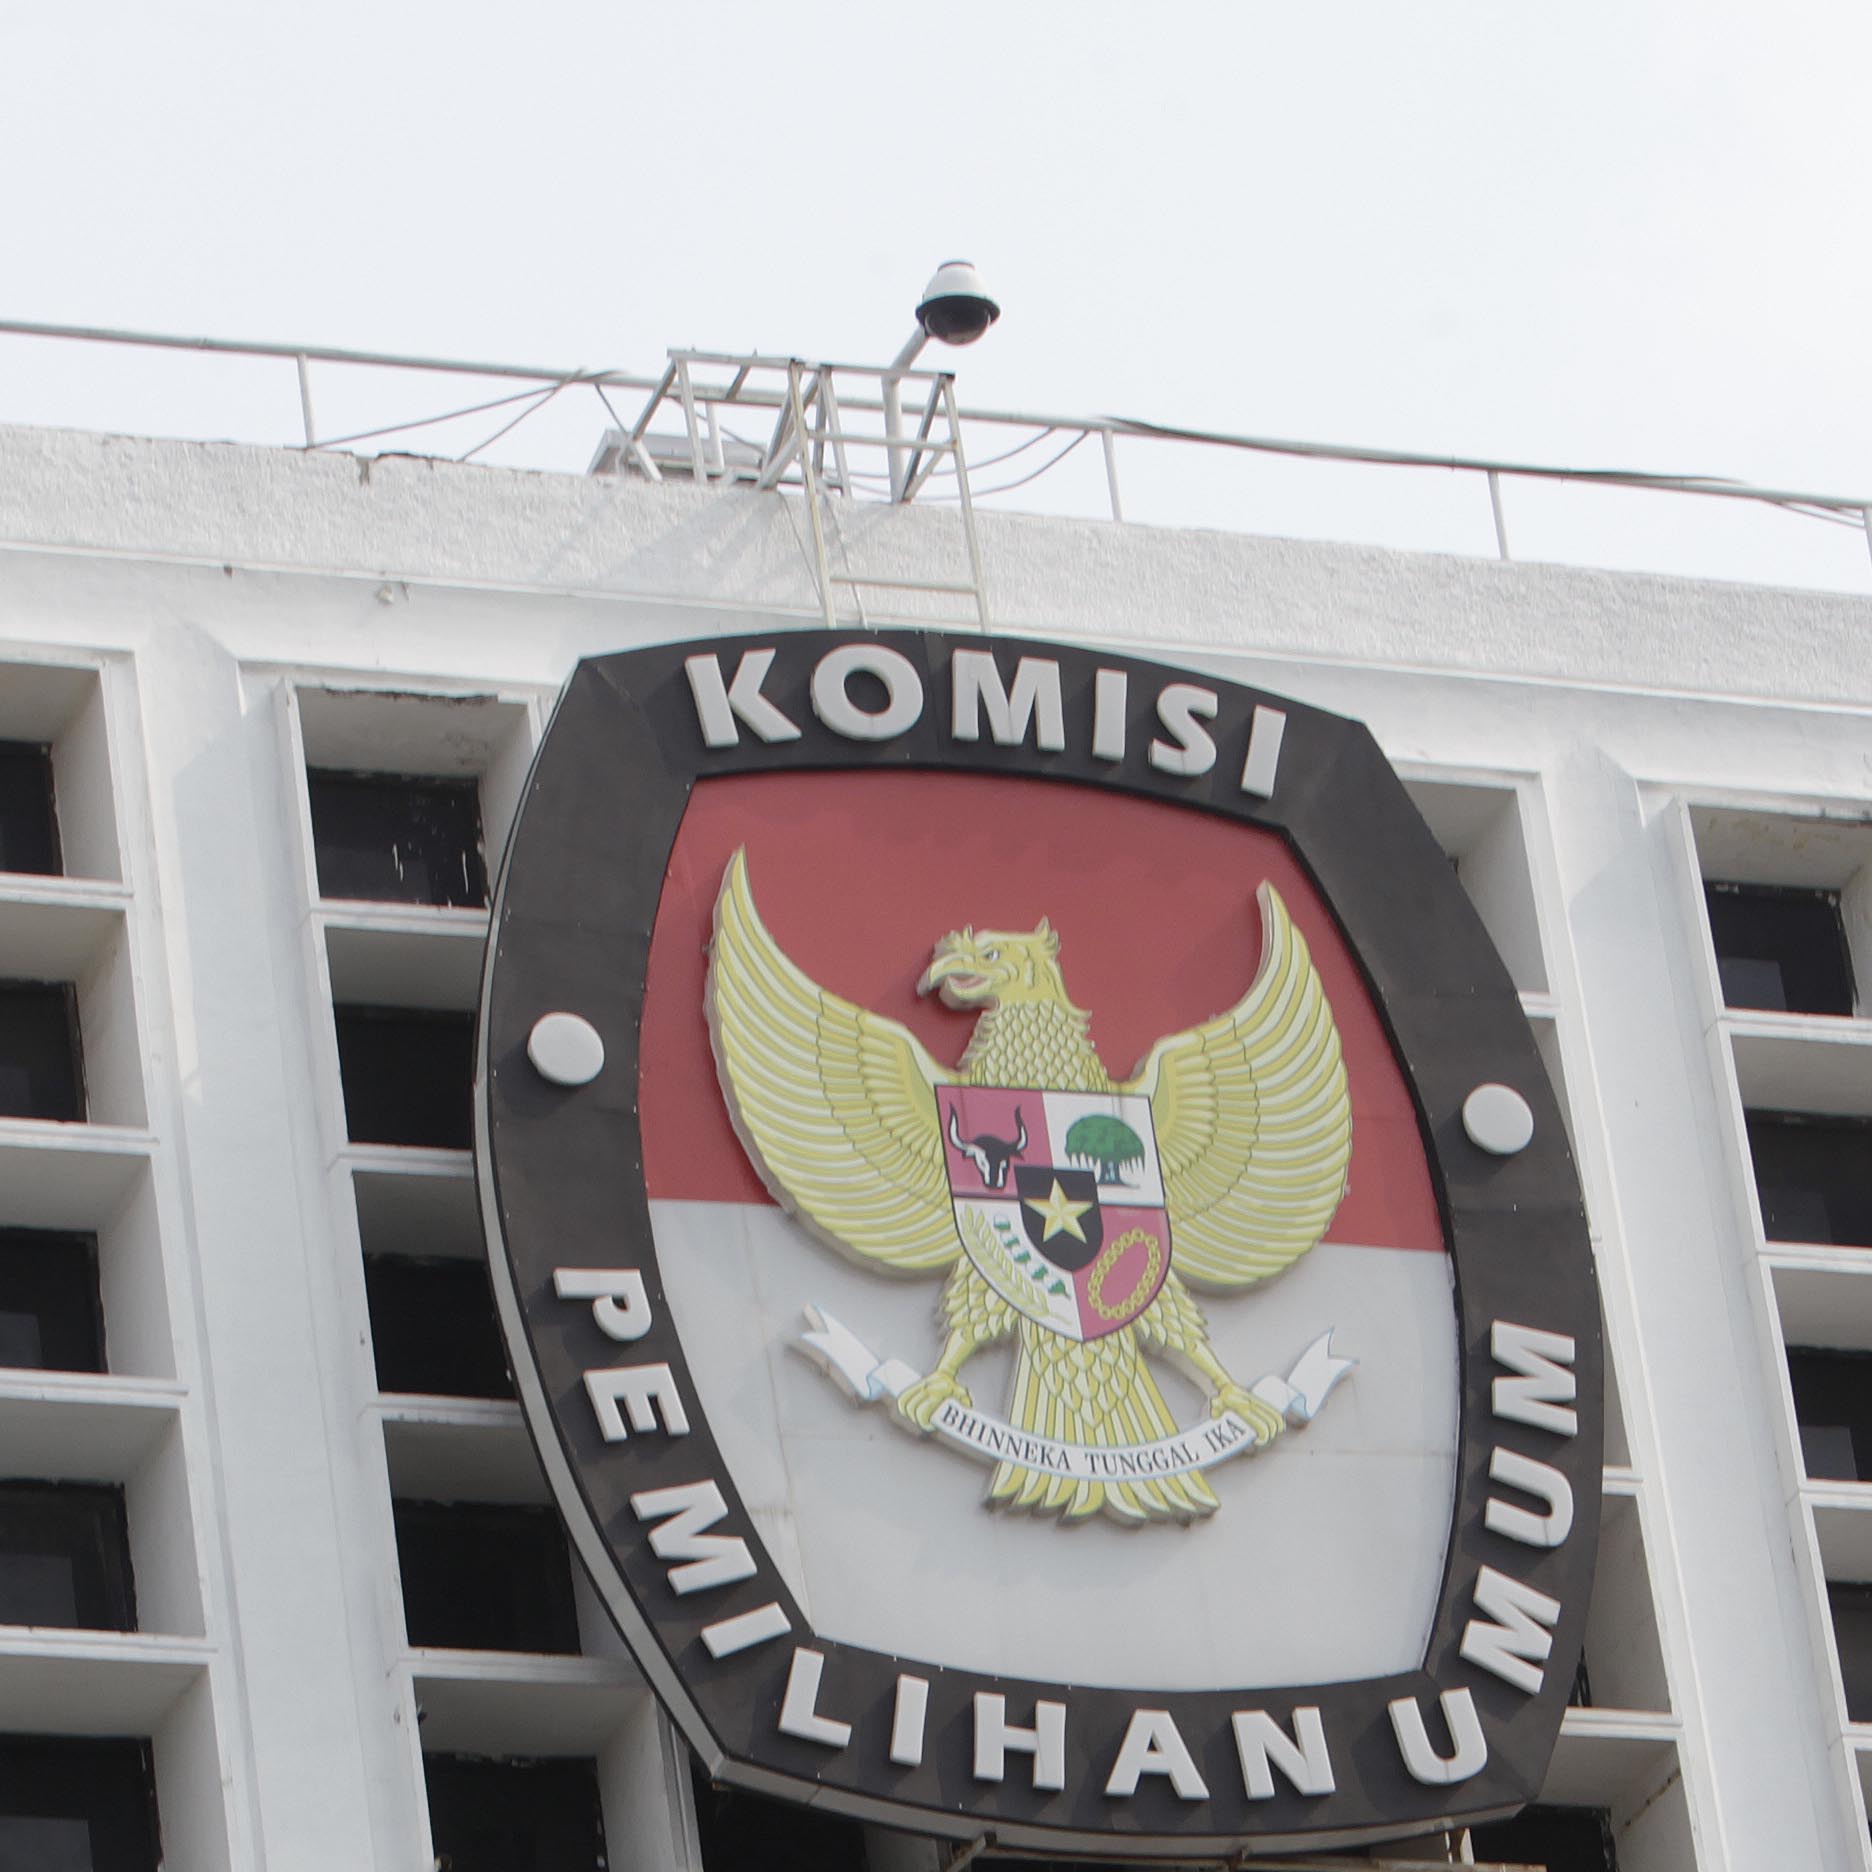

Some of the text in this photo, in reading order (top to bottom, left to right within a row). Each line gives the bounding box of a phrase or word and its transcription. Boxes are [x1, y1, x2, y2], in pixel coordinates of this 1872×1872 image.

[684, 644, 1286, 798] KOMISI
[941, 1404, 1247, 1476] BHINNEKA TUNGGAL IKA
[553, 1266, 1577, 1799] PEMILIHAN UMUM
